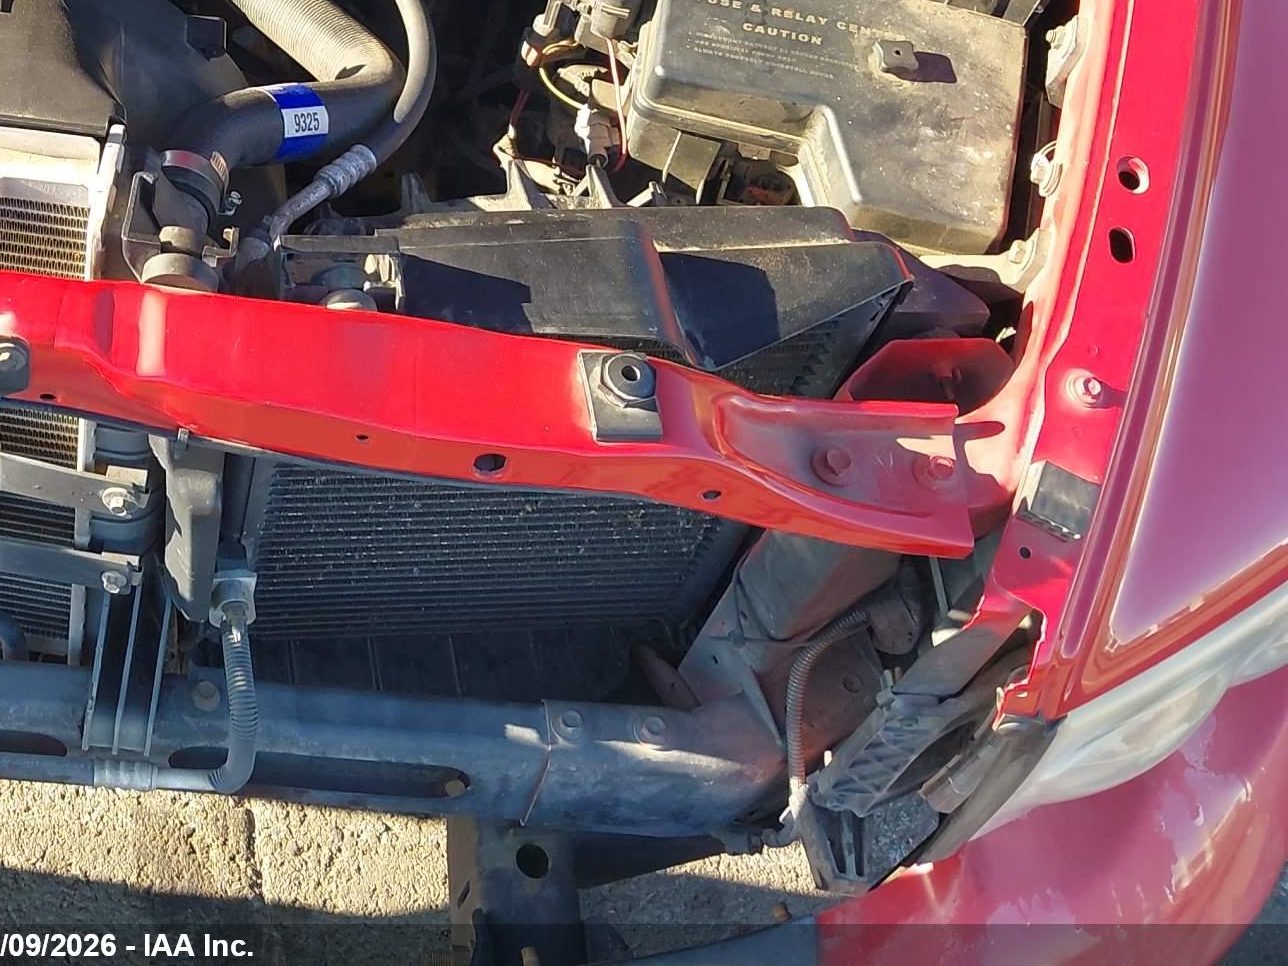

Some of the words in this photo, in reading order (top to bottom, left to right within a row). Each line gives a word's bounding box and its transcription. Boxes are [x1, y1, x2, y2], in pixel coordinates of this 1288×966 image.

[750, 3, 762, 14] &
[770, 6, 829, 26] RELAY
[742, 22, 823, 46] CAUTION
[293, 111, 320, 133] 9325
